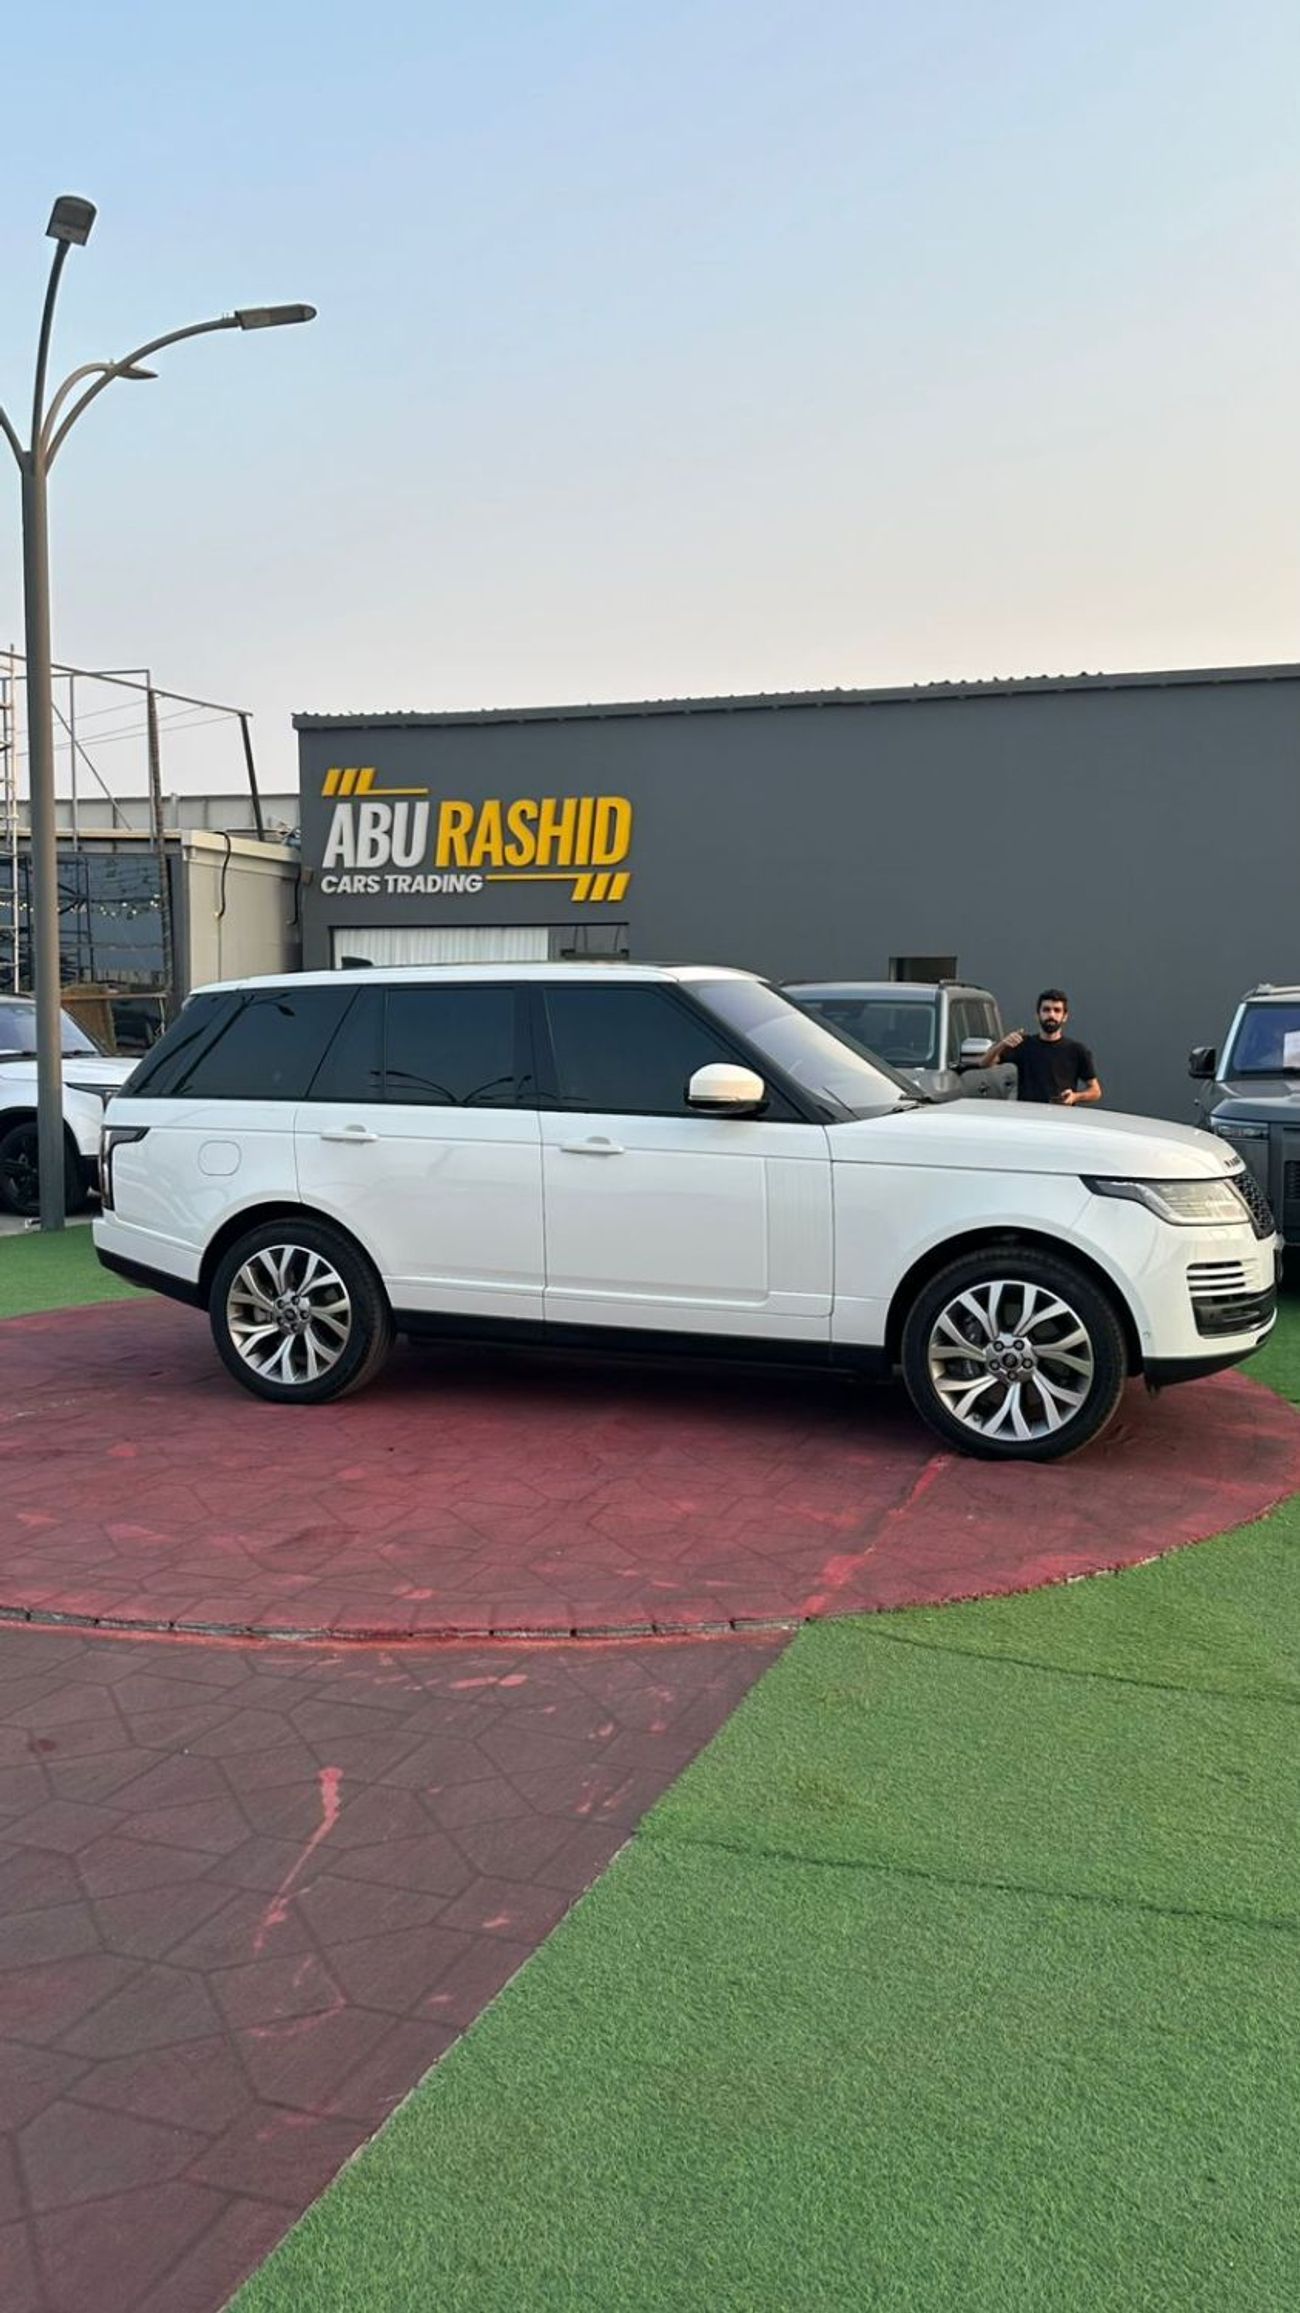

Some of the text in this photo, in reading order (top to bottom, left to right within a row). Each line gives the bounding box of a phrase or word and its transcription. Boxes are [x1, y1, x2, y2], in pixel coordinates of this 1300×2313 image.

[322, 797, 632, 868] ABU RASHID
[320, 874, 483, 893] CARS TRADING
